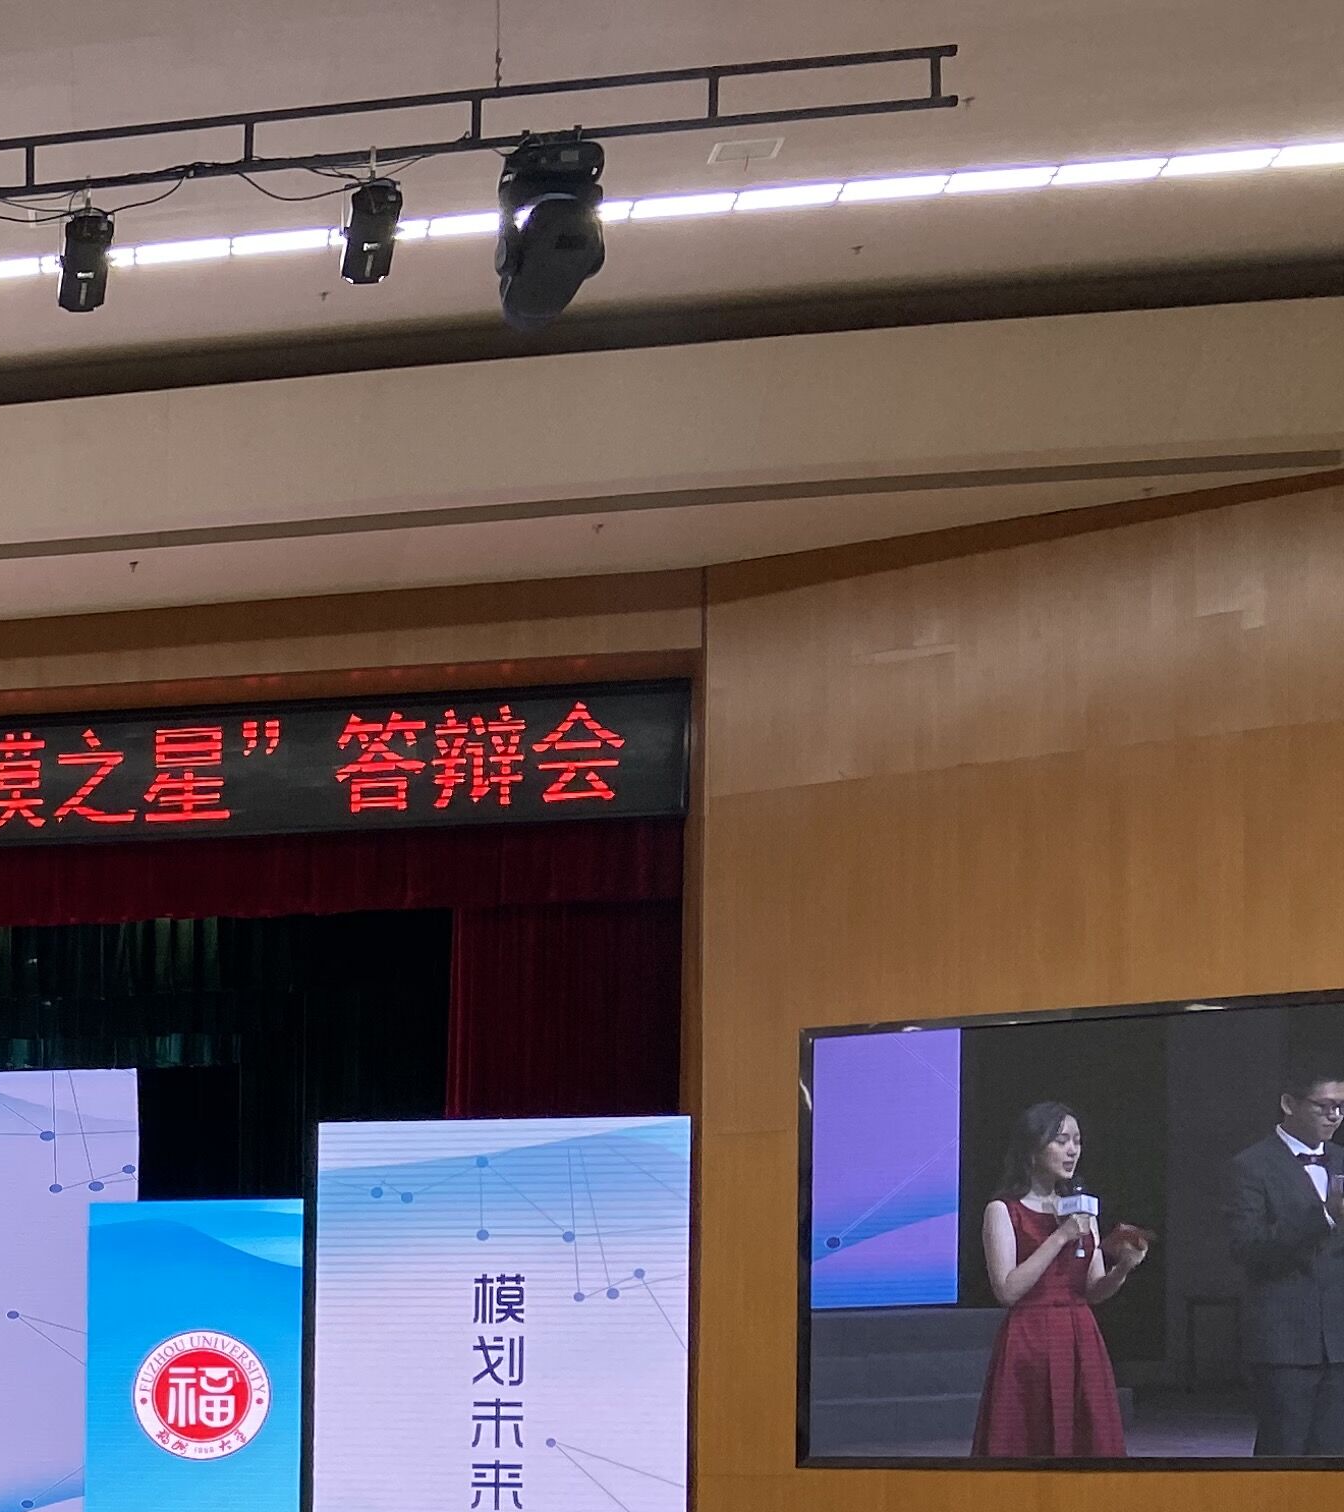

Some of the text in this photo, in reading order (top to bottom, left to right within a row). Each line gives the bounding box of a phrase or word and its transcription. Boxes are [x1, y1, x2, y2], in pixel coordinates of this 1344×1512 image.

[336, 701, 625, 813] 答辩会
[139, 1335, 267, 1394] FUZHOU UNIVERSITY
[167, 1366, 240, 1428] 福
[470, 1272, 526, 1511] 模划未来
